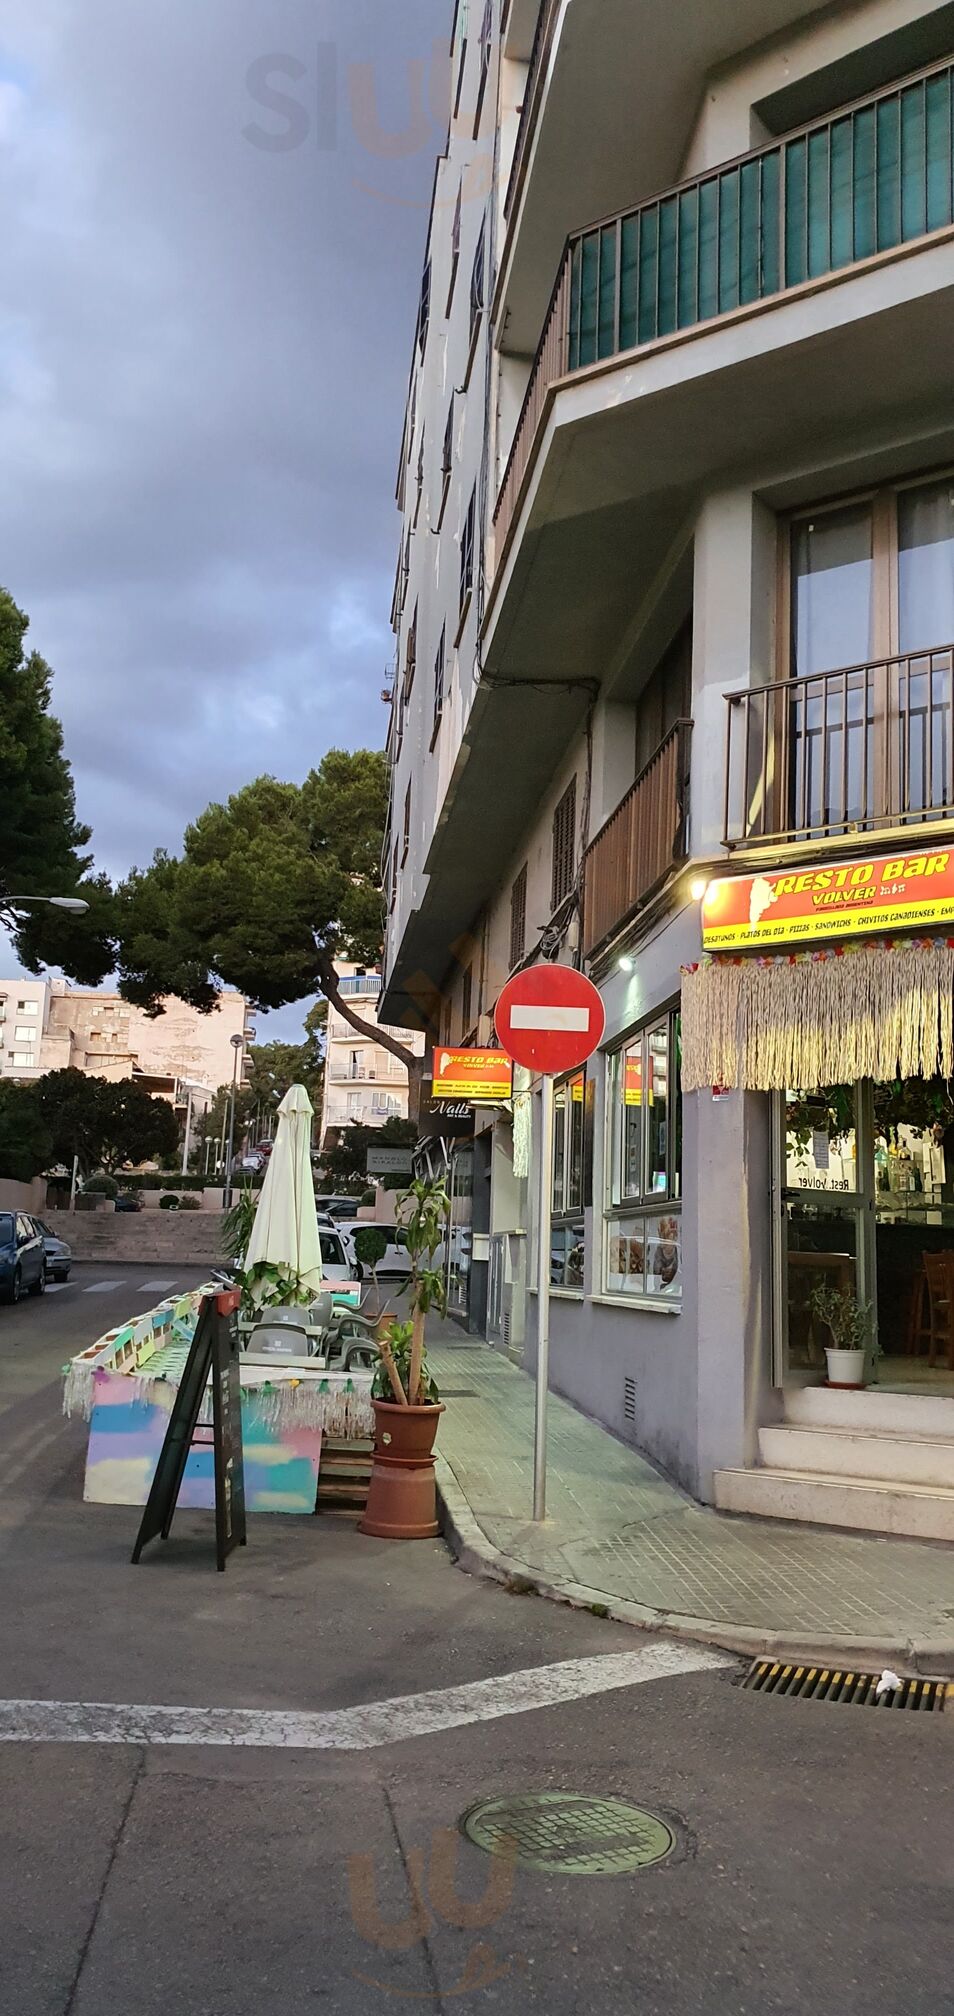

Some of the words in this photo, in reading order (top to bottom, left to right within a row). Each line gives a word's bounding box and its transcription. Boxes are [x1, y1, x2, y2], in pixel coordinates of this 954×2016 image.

[774, 864, 875, 897] RESTO
[812, 886, 877, 905] VOLVER
[858, 913, 889, 925] CHIVITOS
